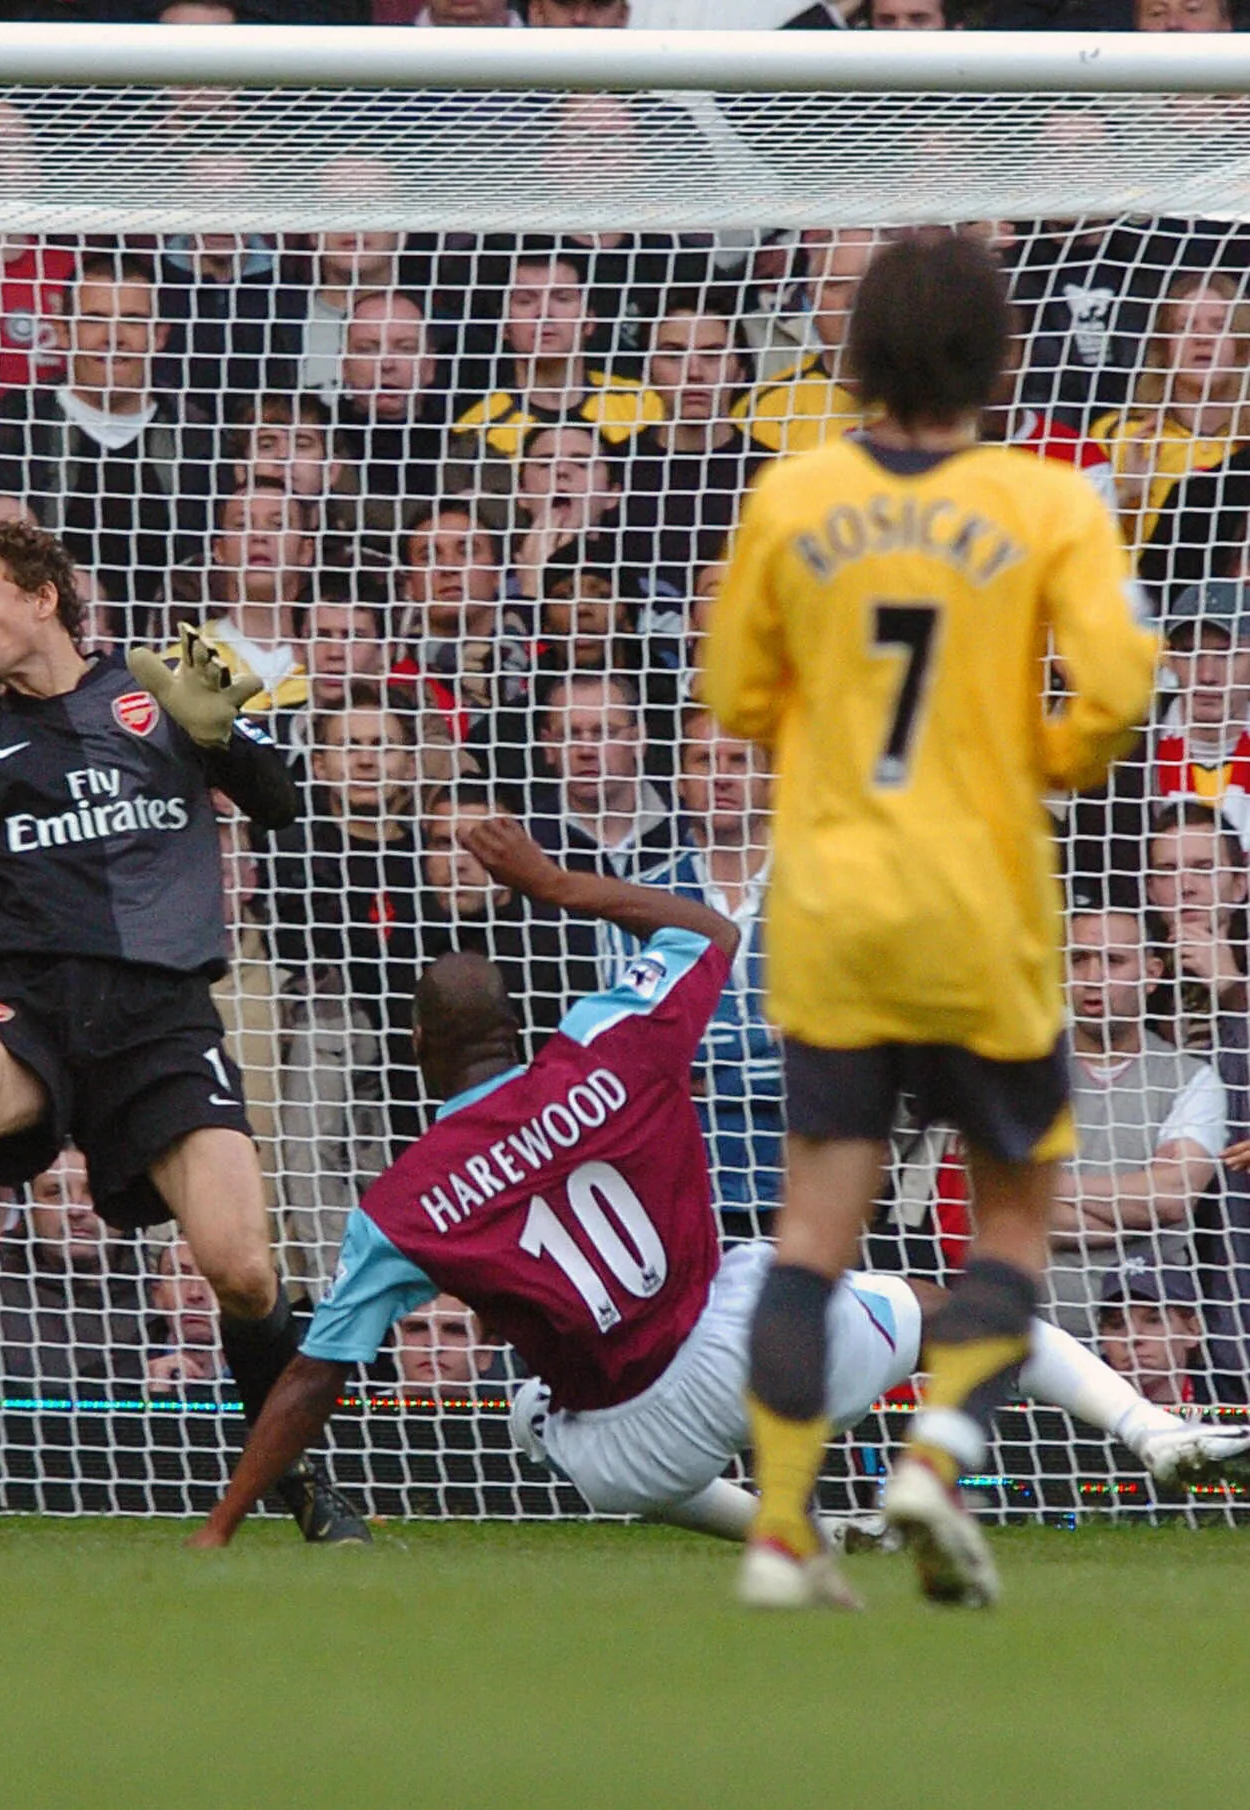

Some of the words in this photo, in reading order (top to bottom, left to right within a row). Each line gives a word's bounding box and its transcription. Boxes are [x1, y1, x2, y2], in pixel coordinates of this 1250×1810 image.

[797, 494, 1026, 586] ROSICKY
[868, 601, 940, 787] 7
[5, 794, 188, 852] Emirates
[65, 767, 120, 799] Fly
[420, 1068, 627, 1234] HAREWOOD
[519, 1160, 668, 1334] 10
